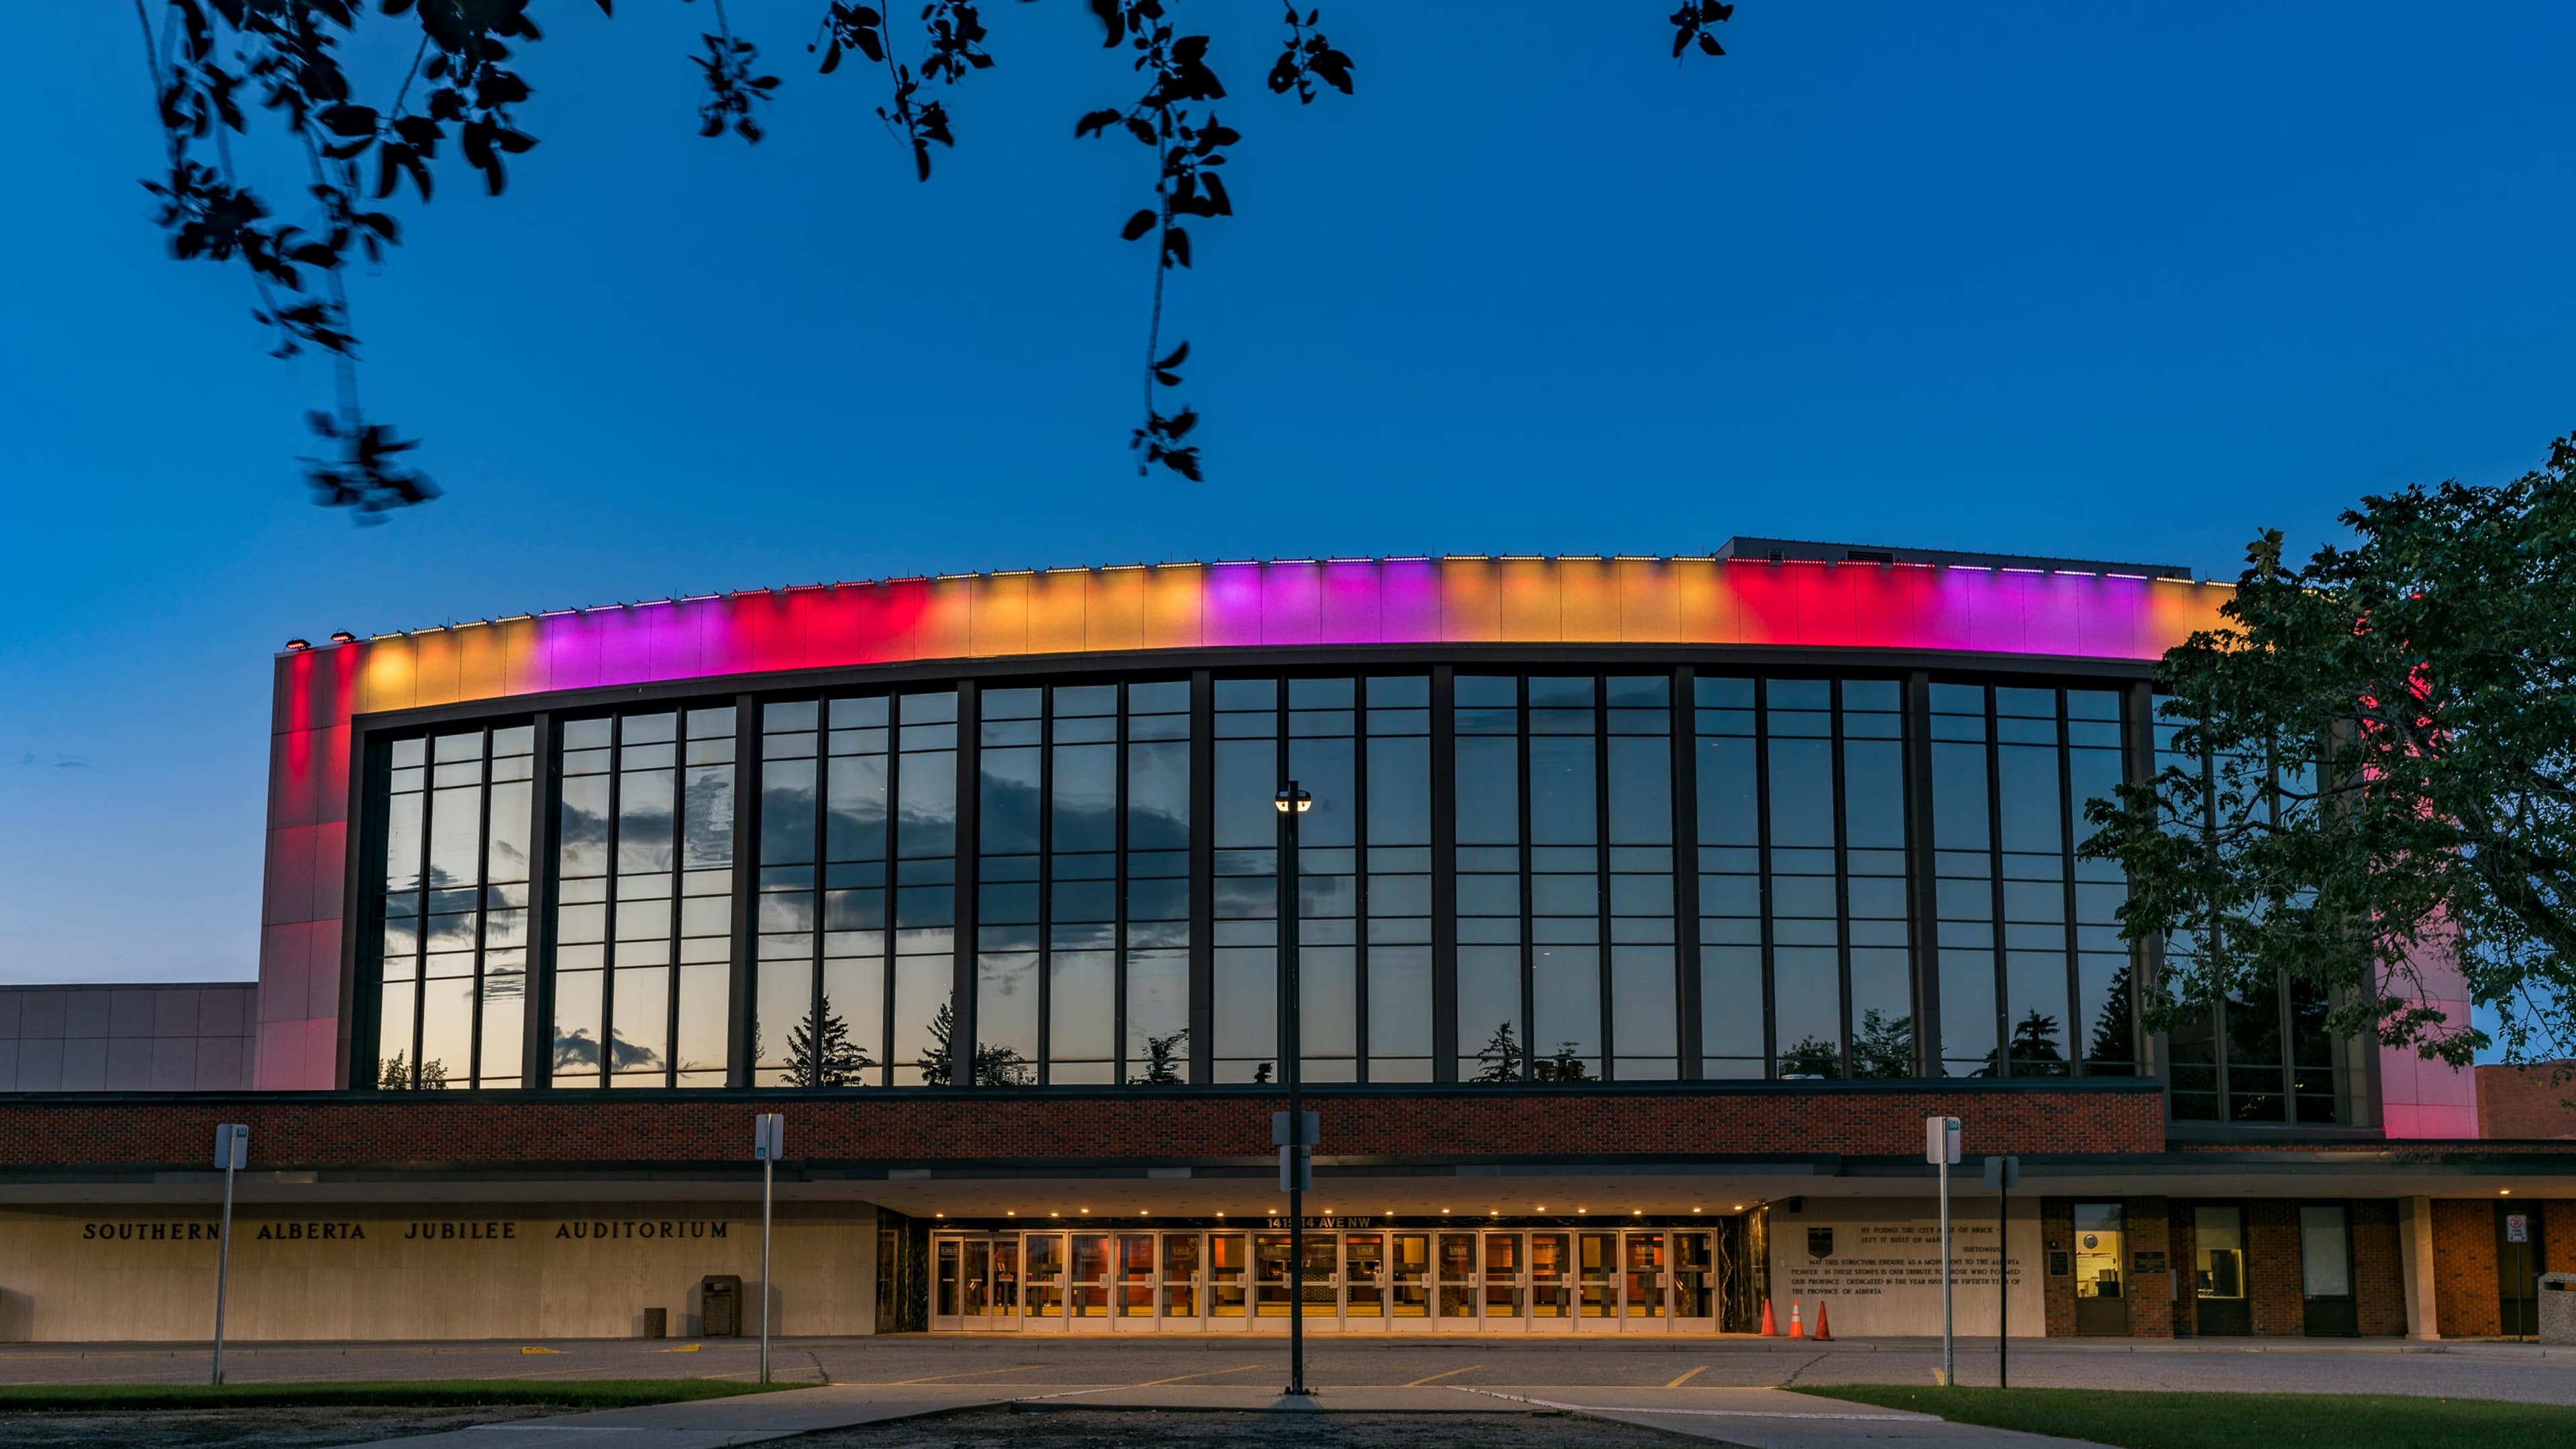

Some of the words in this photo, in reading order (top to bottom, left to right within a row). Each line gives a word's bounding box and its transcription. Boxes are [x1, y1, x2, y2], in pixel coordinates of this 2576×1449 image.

[1319, 1217, 1345, 1228] AVE
[1348, 1217, 1370, 1228] NW
[83, 1223, 220, 1240] SOUTHERN
[256, 1222, 366, 1240] ALBERTA
[405, 1222, 516, 1239] JUBILEE
[556, 1221, 729, 1238] AUDITORIUM
